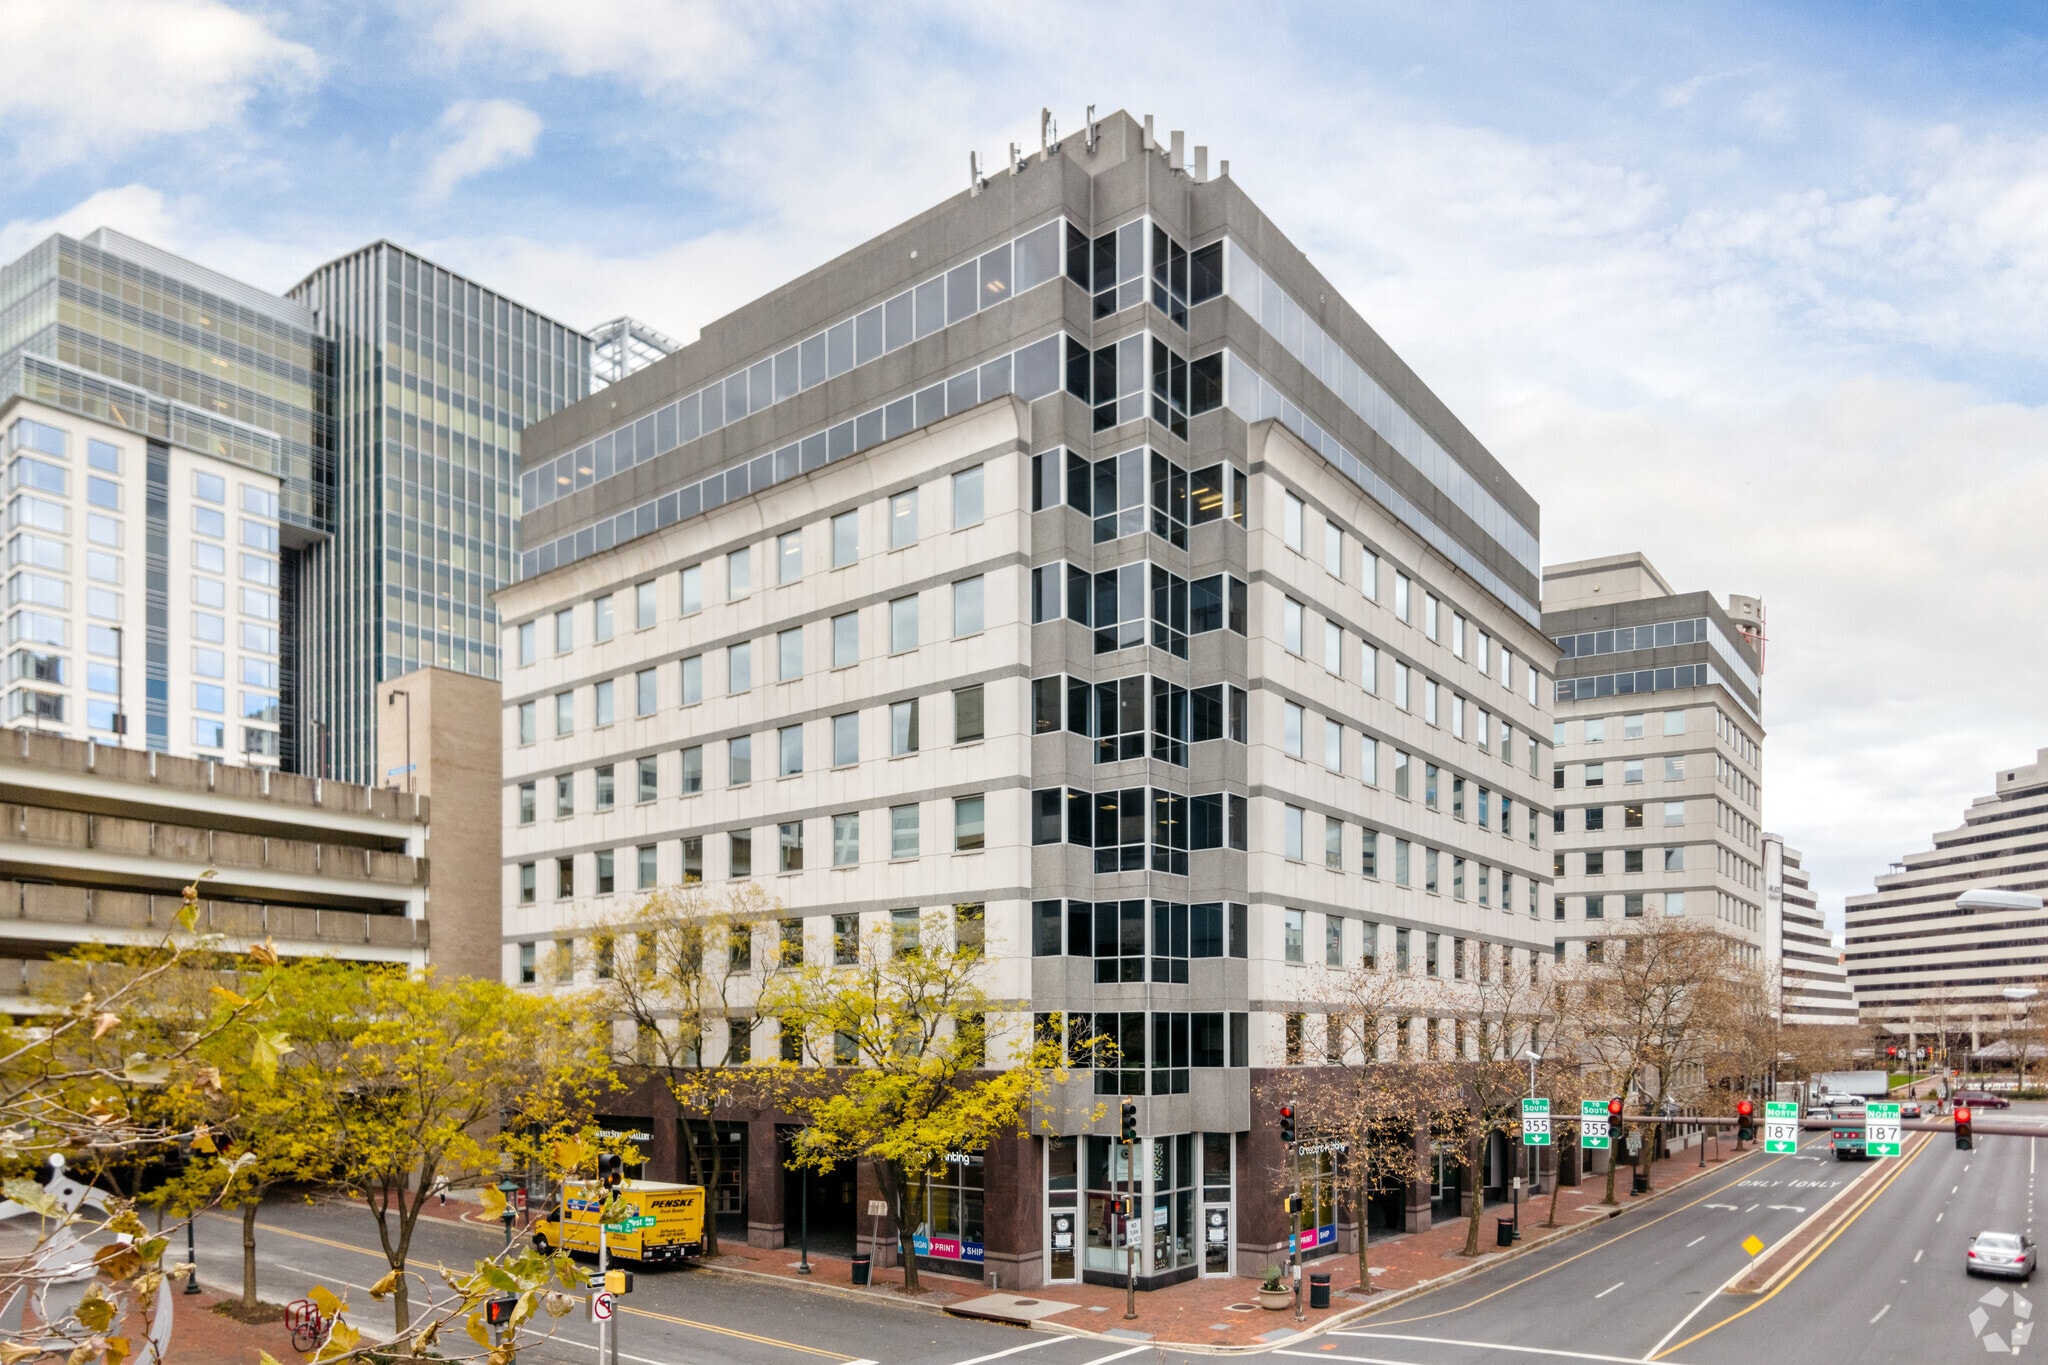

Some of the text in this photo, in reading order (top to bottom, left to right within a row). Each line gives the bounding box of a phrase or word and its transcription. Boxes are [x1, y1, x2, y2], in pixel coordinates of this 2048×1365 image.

[1583, 1106, 1608, 1114] SOUTH
[1767, 1109, 1797, 1117] NORTH
[1868, 1110, 1899, 1118] NORTH
[1525, 1120, 1548, 1132] 355
[1583, 1123, 1607, 1135] 355
[1767, 1126, 1796, 1139] 187
[1869, 1127, 1898, 1140] 187
[651, 1199, 694, 1209] PENSKE
[934, 1243, 955, 1253] PRINT
[966, 1246, 984, 1256] SHIP
